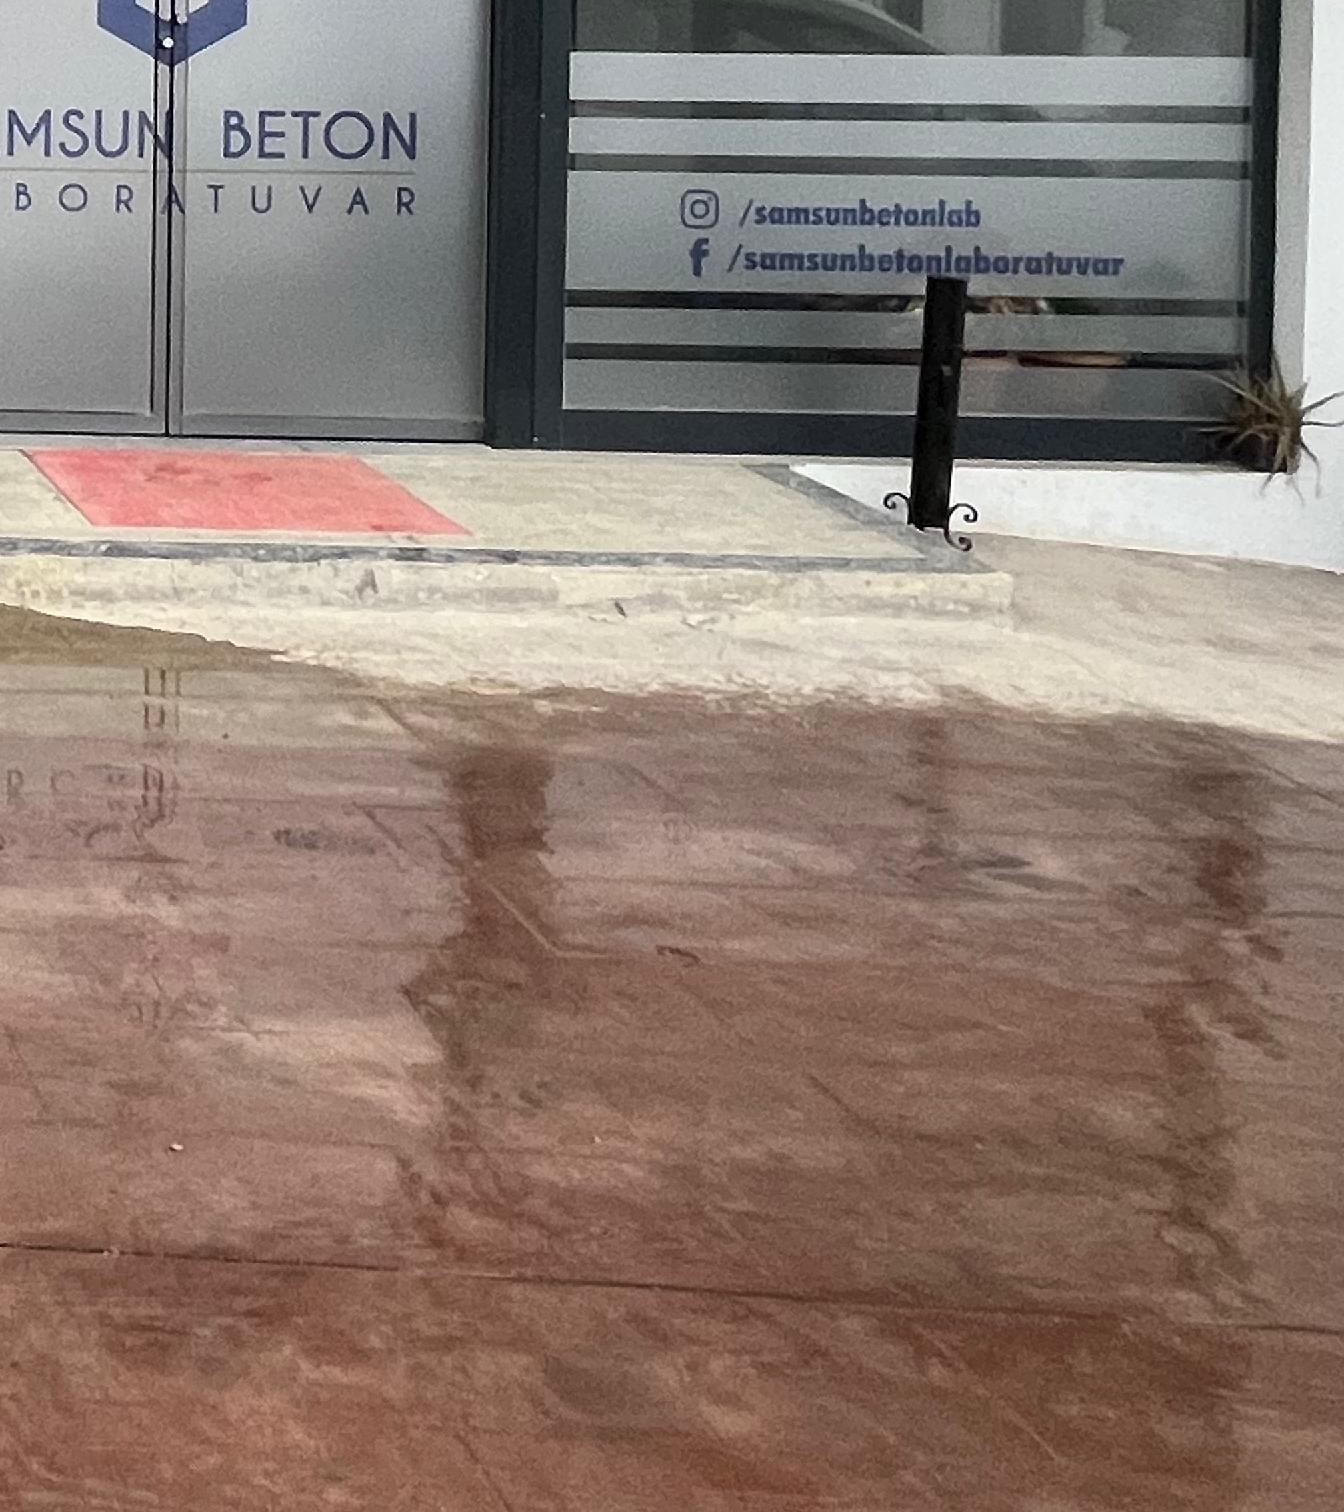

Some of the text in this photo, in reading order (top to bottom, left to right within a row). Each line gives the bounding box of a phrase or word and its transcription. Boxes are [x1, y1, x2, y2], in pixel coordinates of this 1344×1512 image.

[223, 110, 418, 161] BETON
[739, 198, 981, 228] /samsunbetonlab
[727, 244, 1125, 276] /samsunbetonlaboratuvar
